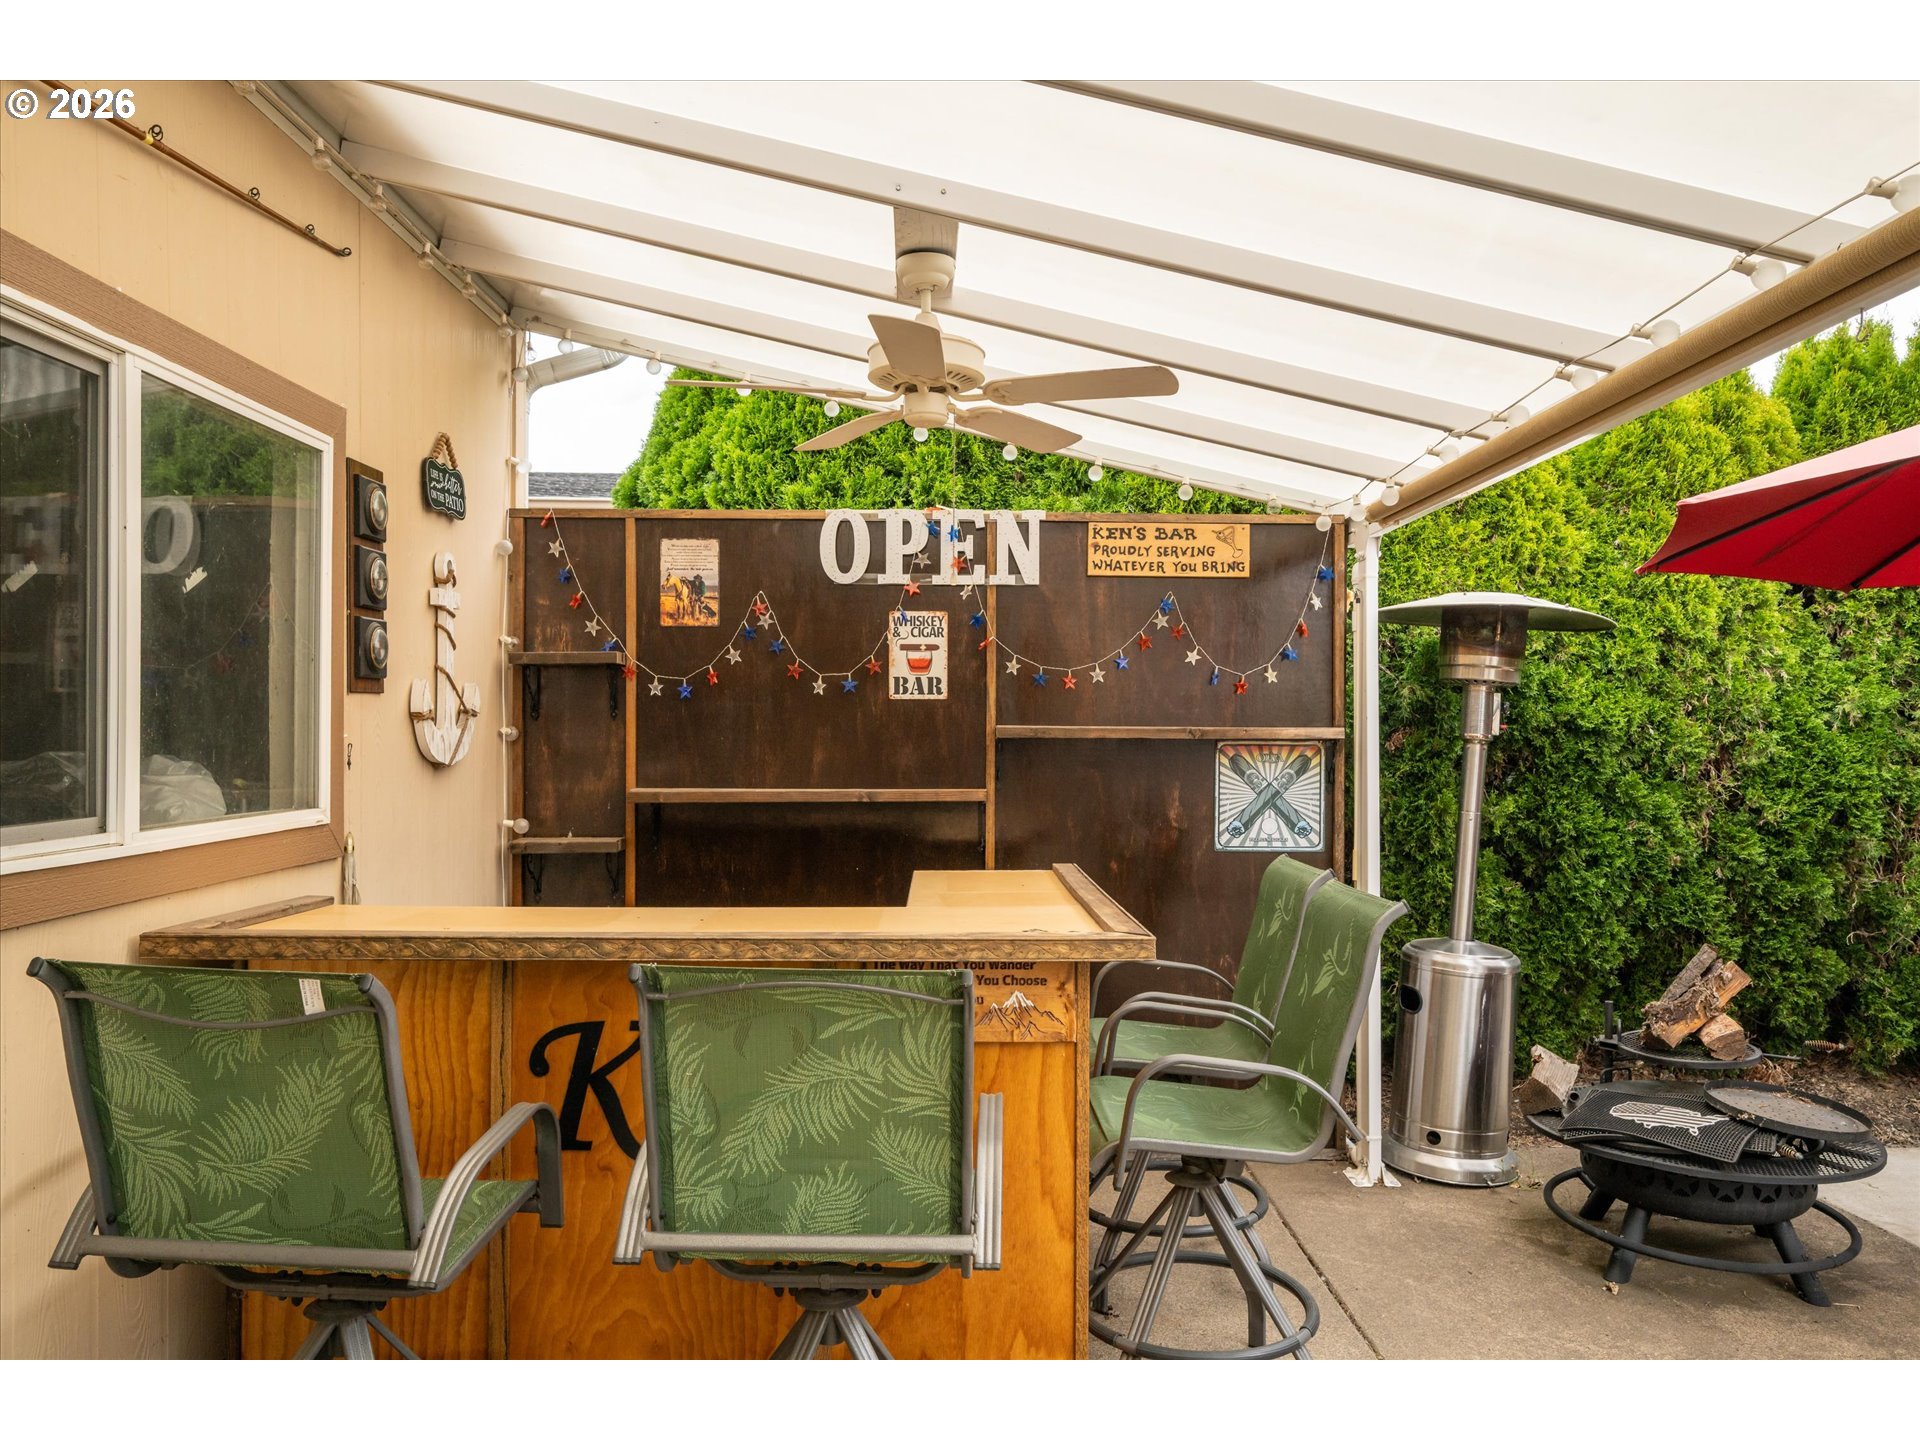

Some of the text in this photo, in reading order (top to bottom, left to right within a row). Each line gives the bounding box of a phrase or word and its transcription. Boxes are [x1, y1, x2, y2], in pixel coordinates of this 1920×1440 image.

[445, 492, 464, 512] PATIO
[1092, 525, 1198, 541] KEN'S BAR
[819, 509, 1046, 585] OPEN
[1093, 544, 1216, 559] PROUDLY SERVING
[1092, 559, 1166, 574] WHATEVER
[1202, 560, 1246, 573] BRING
[892, 615, 945, 627] WHISKEY
[892, 626, 945, 638] & CIGAR
[892, 676, 944, 696] BAR
[976, 974, 1048, 986] You Choose
